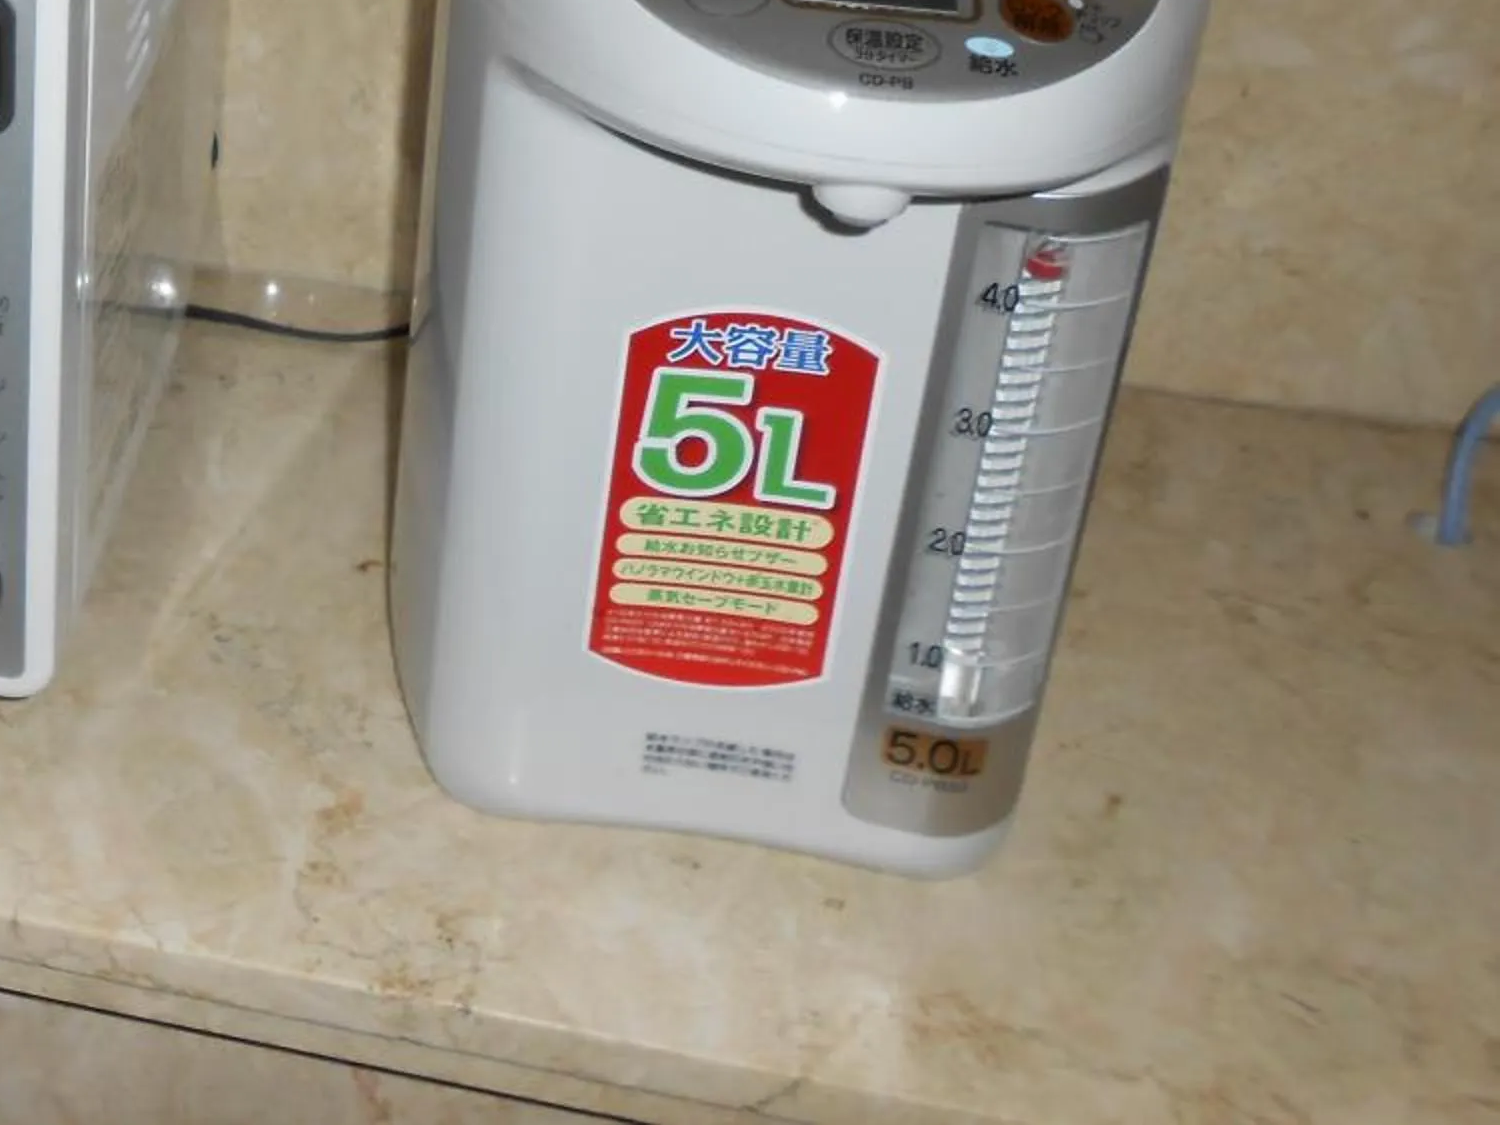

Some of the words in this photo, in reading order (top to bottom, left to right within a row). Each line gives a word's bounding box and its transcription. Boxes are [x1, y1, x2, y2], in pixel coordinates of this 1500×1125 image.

[968, 53, 1020, 77] 給水
[981, 281, 1020, 313] 4.0
[667, 320, 831, 375] 大容量
[632, 366, 836, 509] 5L
[636, 503, 812, 543] 省エネ設計
